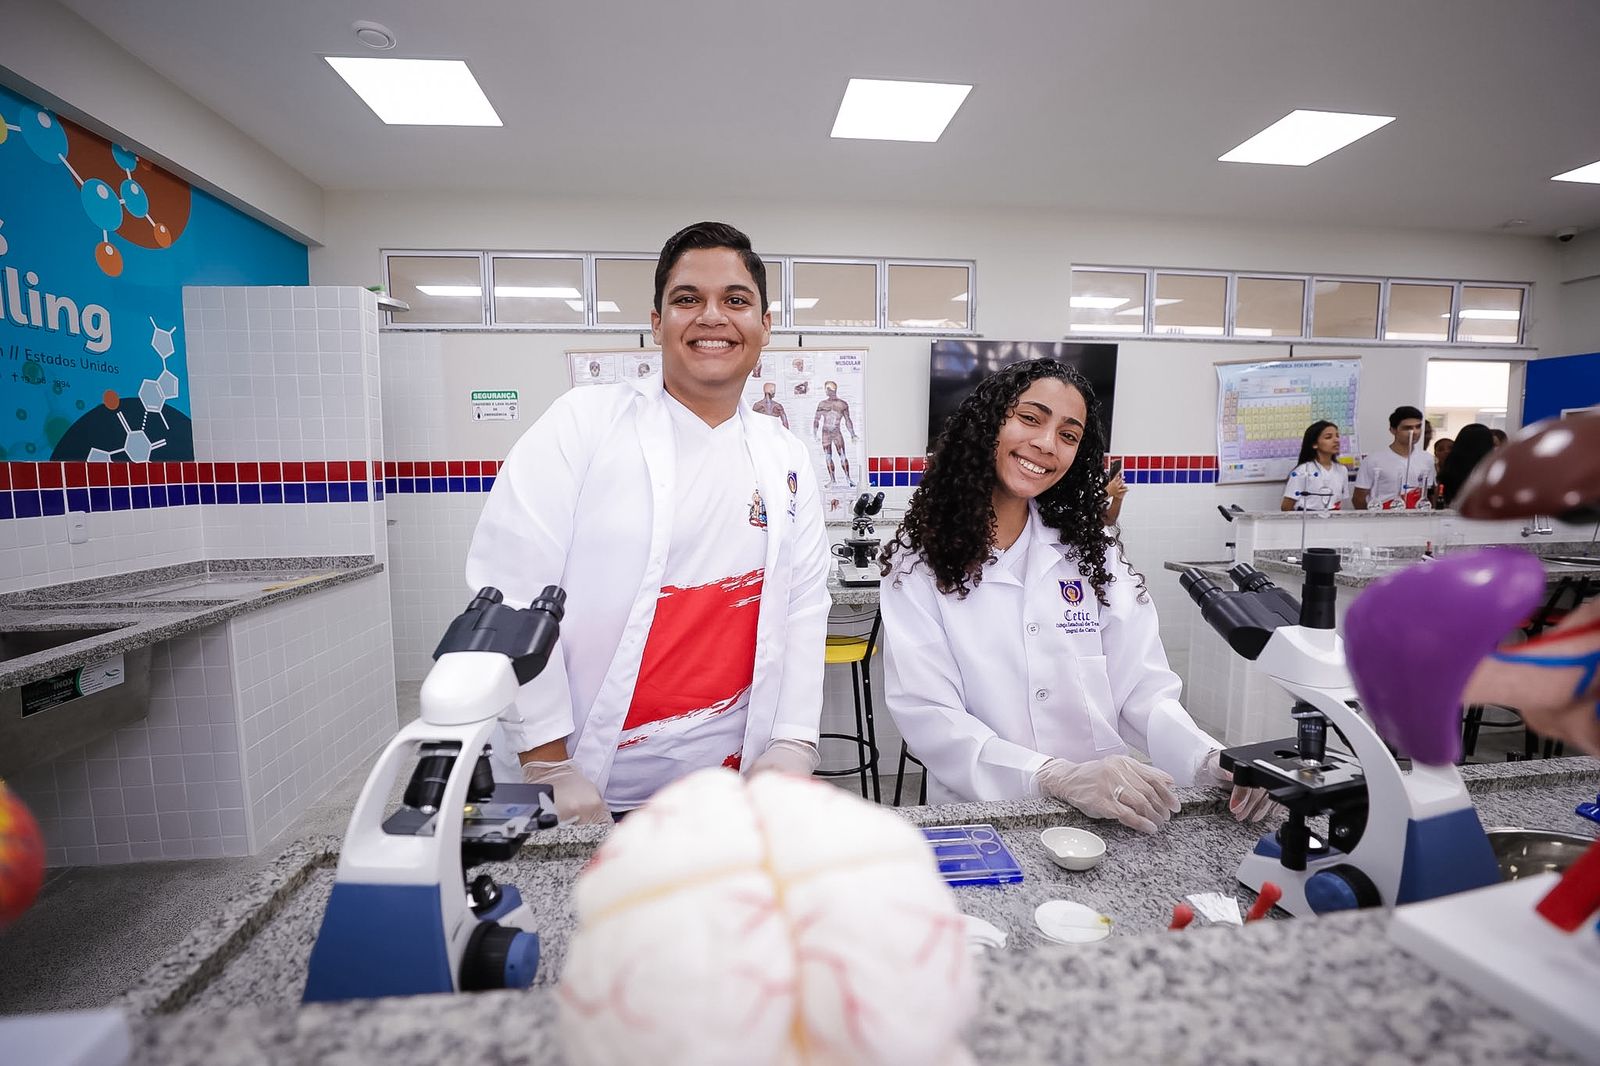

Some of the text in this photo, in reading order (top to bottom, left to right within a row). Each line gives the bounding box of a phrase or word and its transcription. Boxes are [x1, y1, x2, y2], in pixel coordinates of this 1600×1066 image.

[0, 266, 112, 353] ling
[25, 348, 76, 368] Estados
[80, 357, 120, 375] Unidos
[53, 677, 74, 690] INOX
